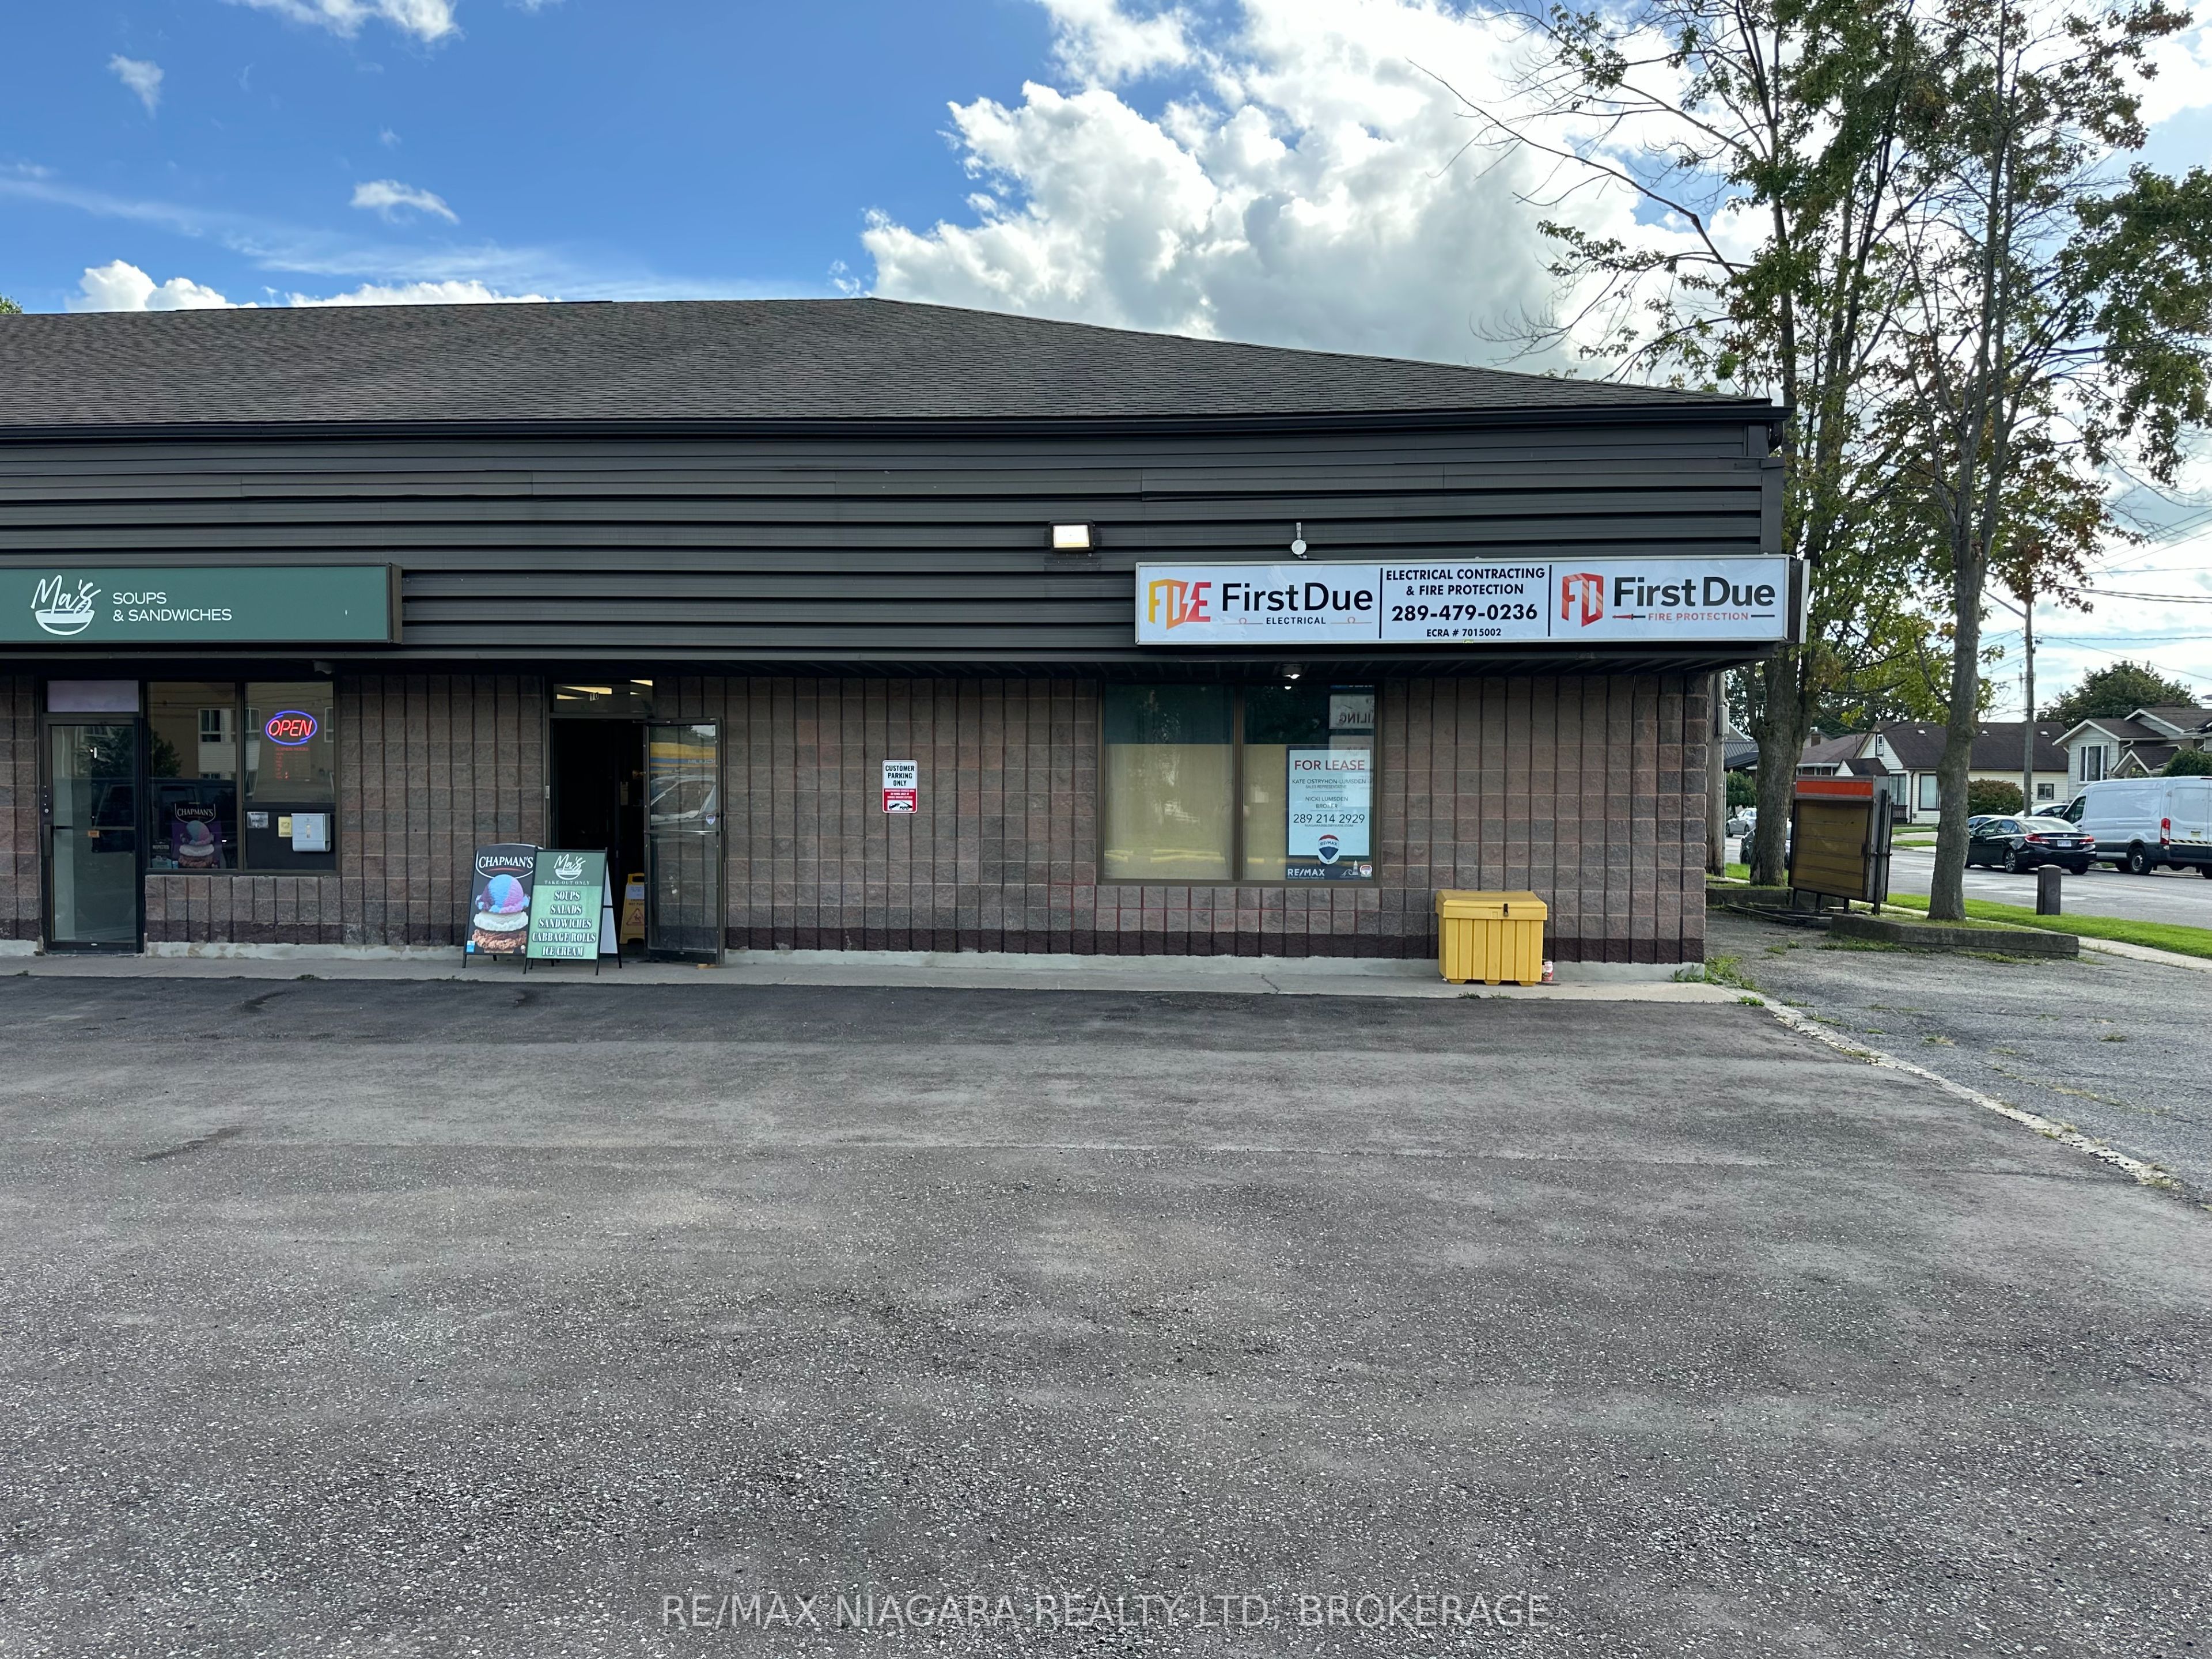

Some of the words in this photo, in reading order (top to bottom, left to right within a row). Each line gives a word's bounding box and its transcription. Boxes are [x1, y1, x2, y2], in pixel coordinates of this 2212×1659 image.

[1386, 569, 1453, 581] ELECTRICAL
[1456, 568, 1545, 579] CONTRACTING
[31, 575, 101, 615] Ma's
[1406, 586, 1415, 596] &
[1419, 585, 1444, 596] FIRE
[1449, 584, 1524, 595] PROTECTION
[113, 592, 167, 605] SOUPS
[113, 609, 124, 622] &
[128, 608, 232, 622] SANDWICHES
[1391, 604, 1538, 622] 289-479-0236
[1648, 613, 1673, 621] FIRE
[1676, 612, 1749, 621] PROTECTION
[1266, 617, 1326, 625] ELECTRICAL
[1426, 629, 1450, 638] ECRA
[1452, 629, 1459, 637] #
[1461, 628, 1502, 637] 7015002
[268, 719, 312, 737] OPEN
[1295, 760, 1321, 770] FOR
[1325, 760, 1365, 770] LEASE
[177, 808, 214, 817] CHAPMAN'S
[1293, 813, 1313, 824] 289
[1316, 813, 1335, 824] 214
[1339, 813, 1365, 824] 2929
[479, 856, 533, 869] CHAPMAN'S
[554, 854, 586, 871] Ma's
[554, 891, 580, 900] SOUPS
[551, 905, 582, 915] SALADS
[539, 918, 592, 929] SANDWICHES
[532, 932, 569, 942] CABBAGE
[571, 933, 596, 942] ROLLS
[542, 946, 556, 956] ICE
[557, 946, 584, 956] CREAM
